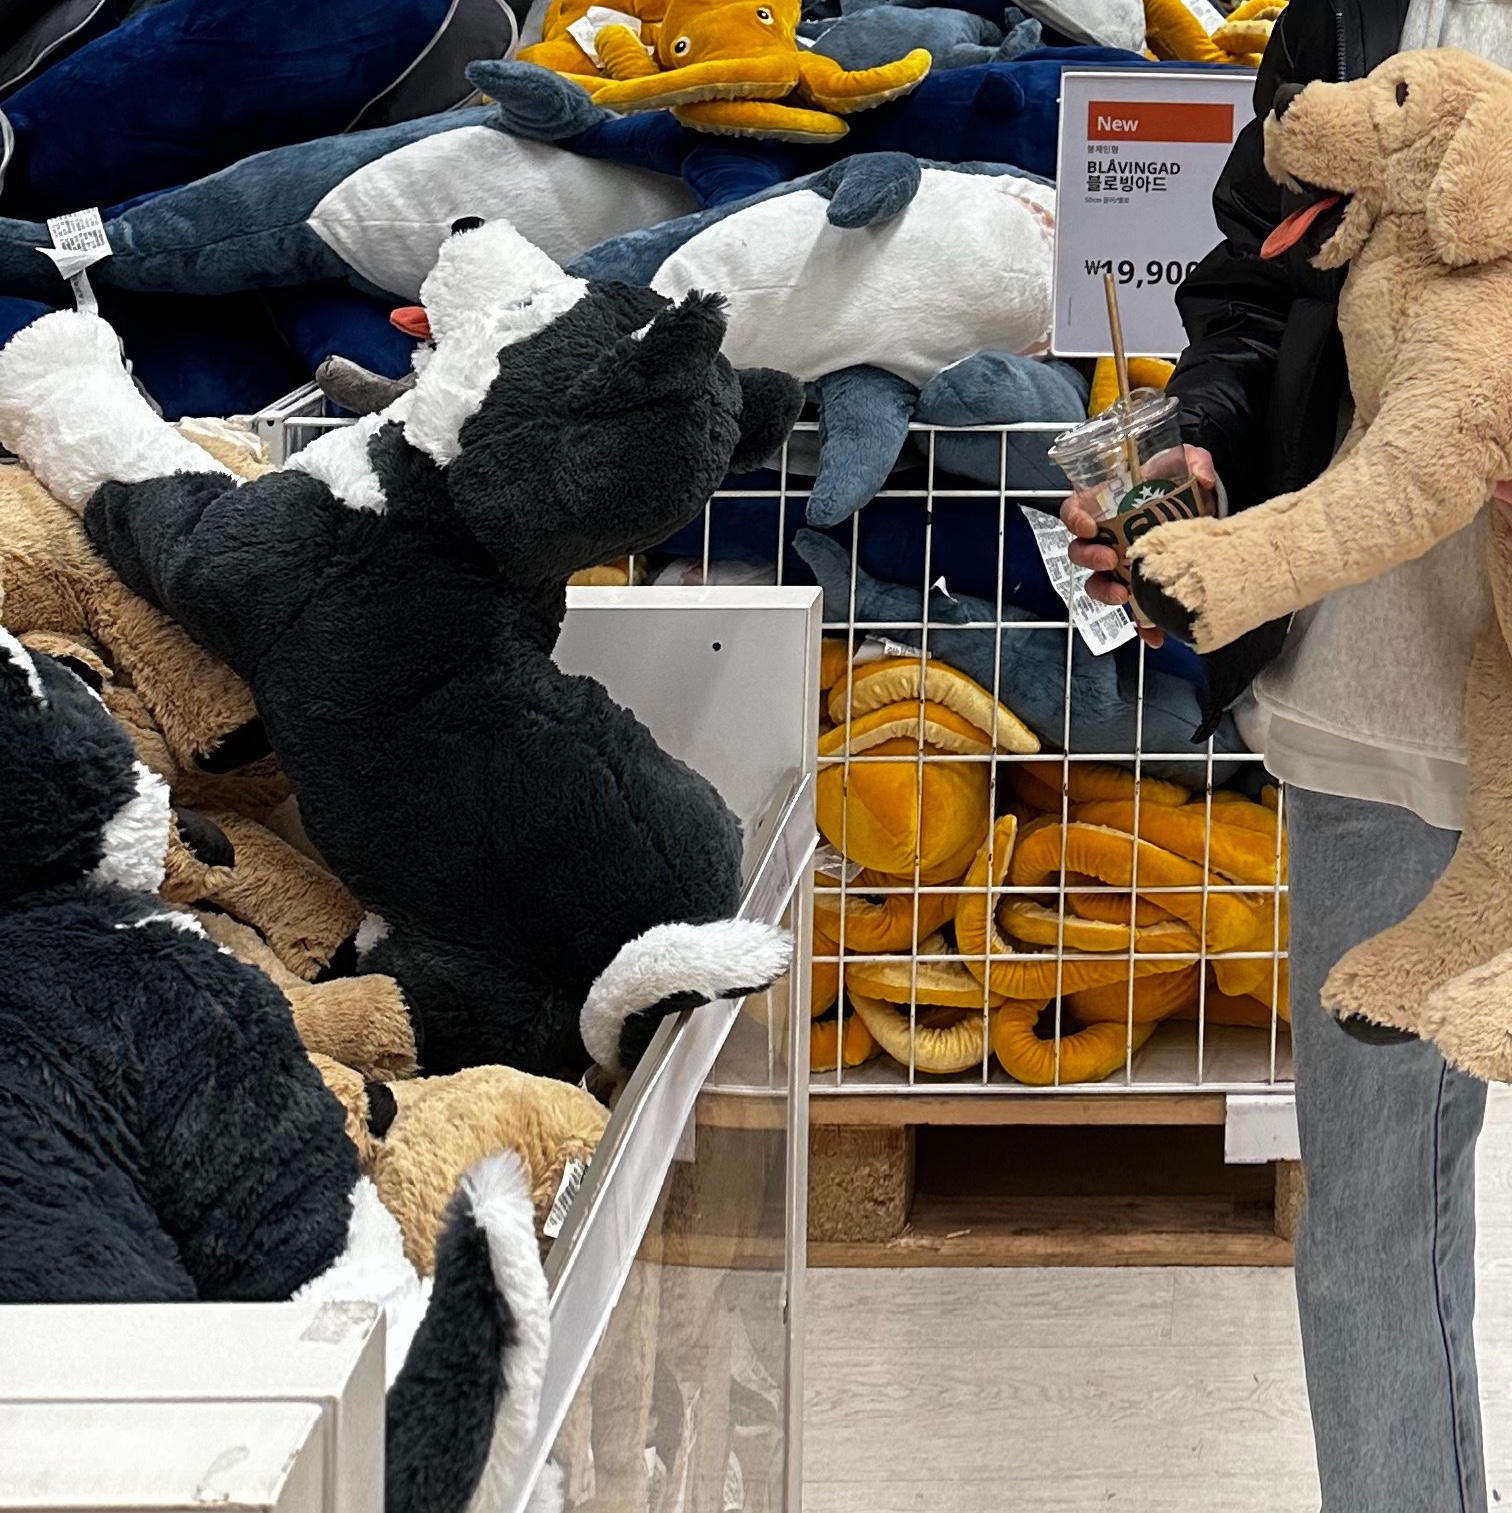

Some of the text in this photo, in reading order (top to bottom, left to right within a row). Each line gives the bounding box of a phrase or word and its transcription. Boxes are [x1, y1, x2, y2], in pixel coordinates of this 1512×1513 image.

[1097, 116, 1139, 132] New
[1087, 159, 1181, 175] BLÅVINGAD
[1087, 175, 1167, 193] 블로빙아드
